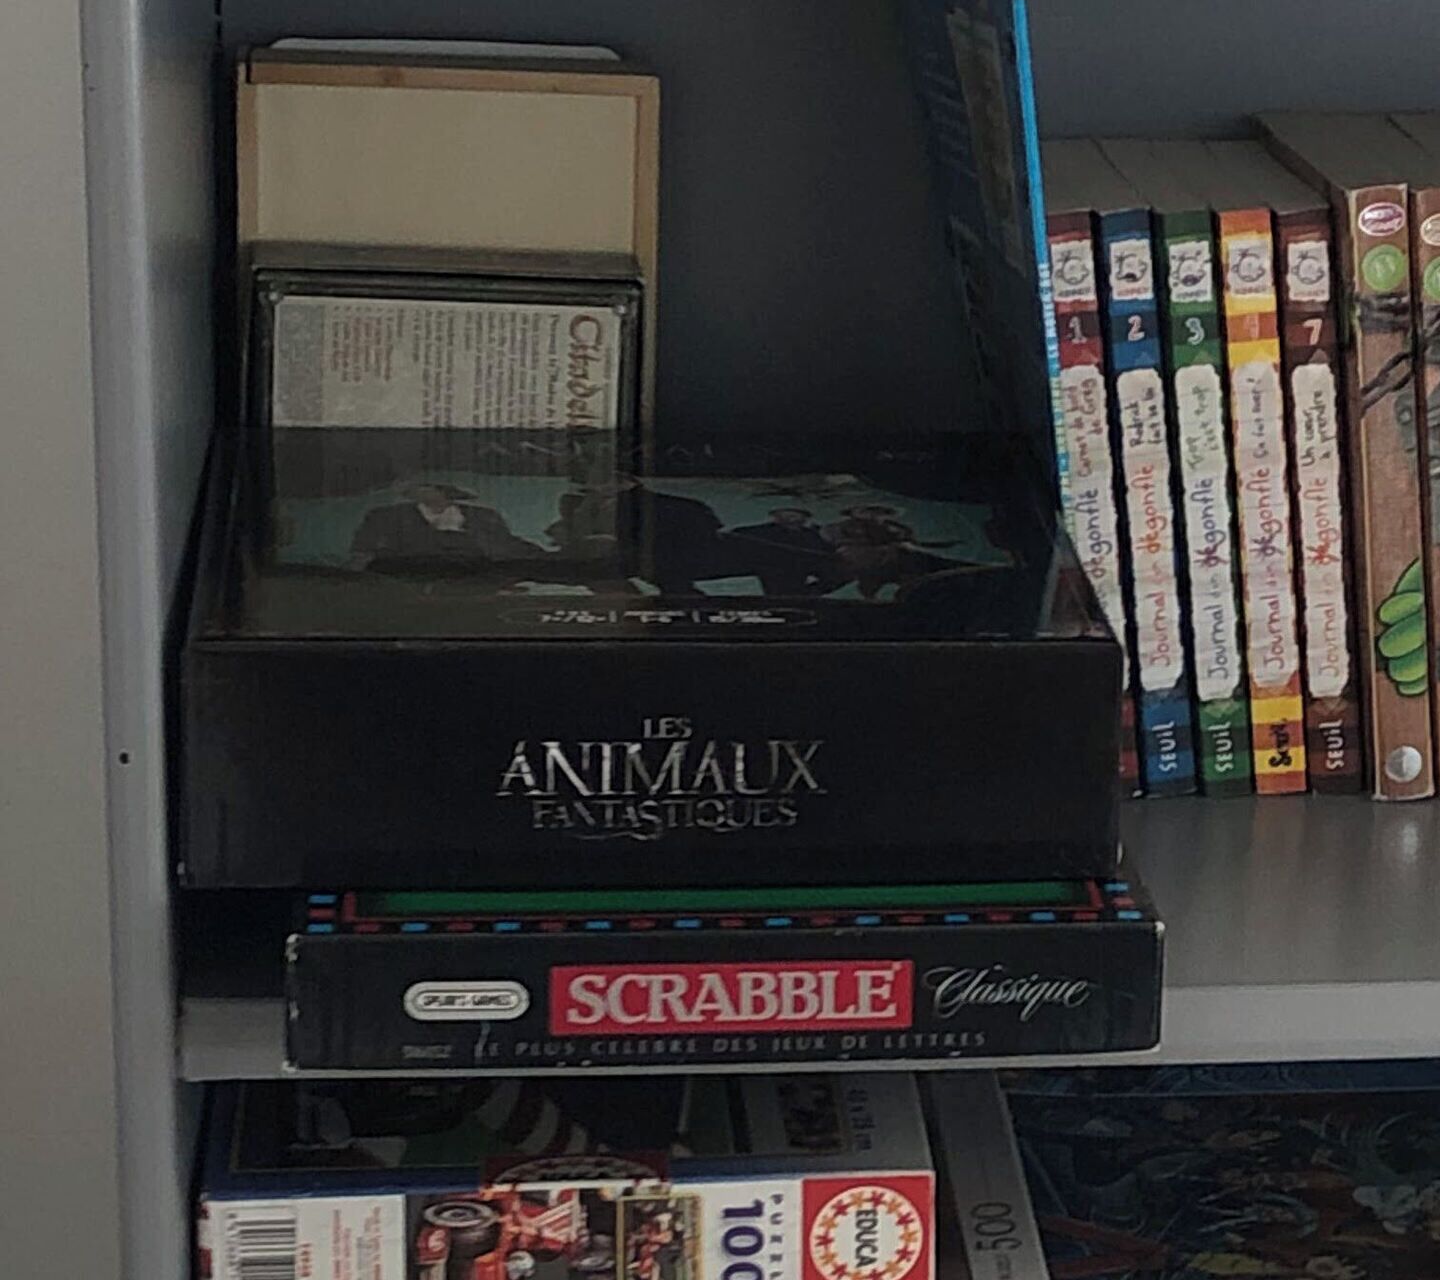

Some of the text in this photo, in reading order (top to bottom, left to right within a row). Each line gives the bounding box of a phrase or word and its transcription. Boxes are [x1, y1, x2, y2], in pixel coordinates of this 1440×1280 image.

[1070, 317, 1087, 344] 1
[1127, 315, 1147, 341] 2
[1186, 319, 1206, 347] 3
[1304, 319, 1323, 346] 7
[1141, 589, 1172, 668] Journal
[1204, 603, 1231, 681] Journal
[1258, 592, 1287, 671] Journal
[1313, 601, 1340, 680] Journal
[642, 716, 692, 740] LES
[495, 739, 828, 797] ANIMAUX
[533, 798, 798, 834] FANTASTIQUES
[565, 965, 1094, 1027] SCRABBLE Classique
[514, 1040, 576, 1058] PLUS
[713, 1036, 758, 1054] DES
[771, 1035, 828, 1053] JEUX
[841, 1035, 871, 1052] DE
[854, 1208, 879, 1269] EDUCA
[973, 1200, 1023, 1252] 500
